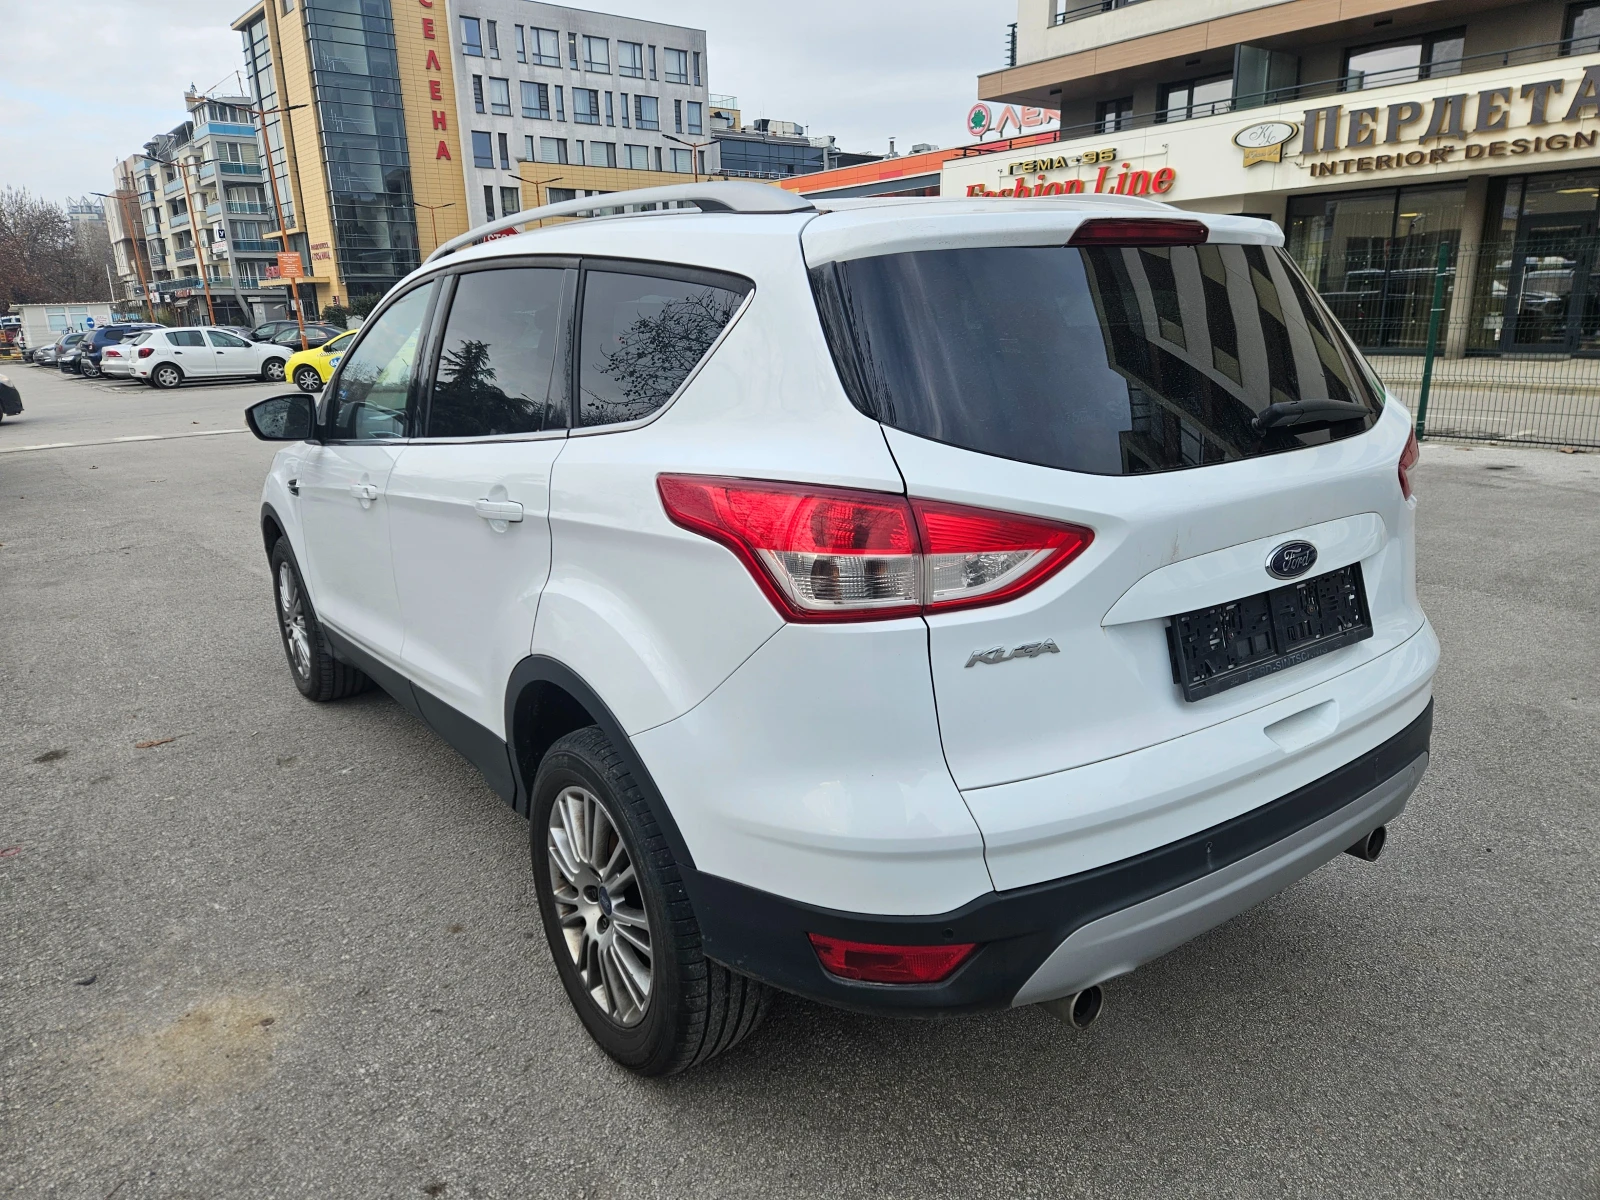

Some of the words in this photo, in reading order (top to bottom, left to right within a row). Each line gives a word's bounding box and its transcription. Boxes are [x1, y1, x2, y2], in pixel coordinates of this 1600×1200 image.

[1300, 65, 1600, 155] ПЕРДЕТА
[1310, 147, 1450, 178] INTERIOR
[1464, 130, 1599, 160] DESIGN
[1094, 162, 1176, 196] Line
[1283, 547, 1310, 571] Ford
[964, 638, 1061, 668] KUGA
